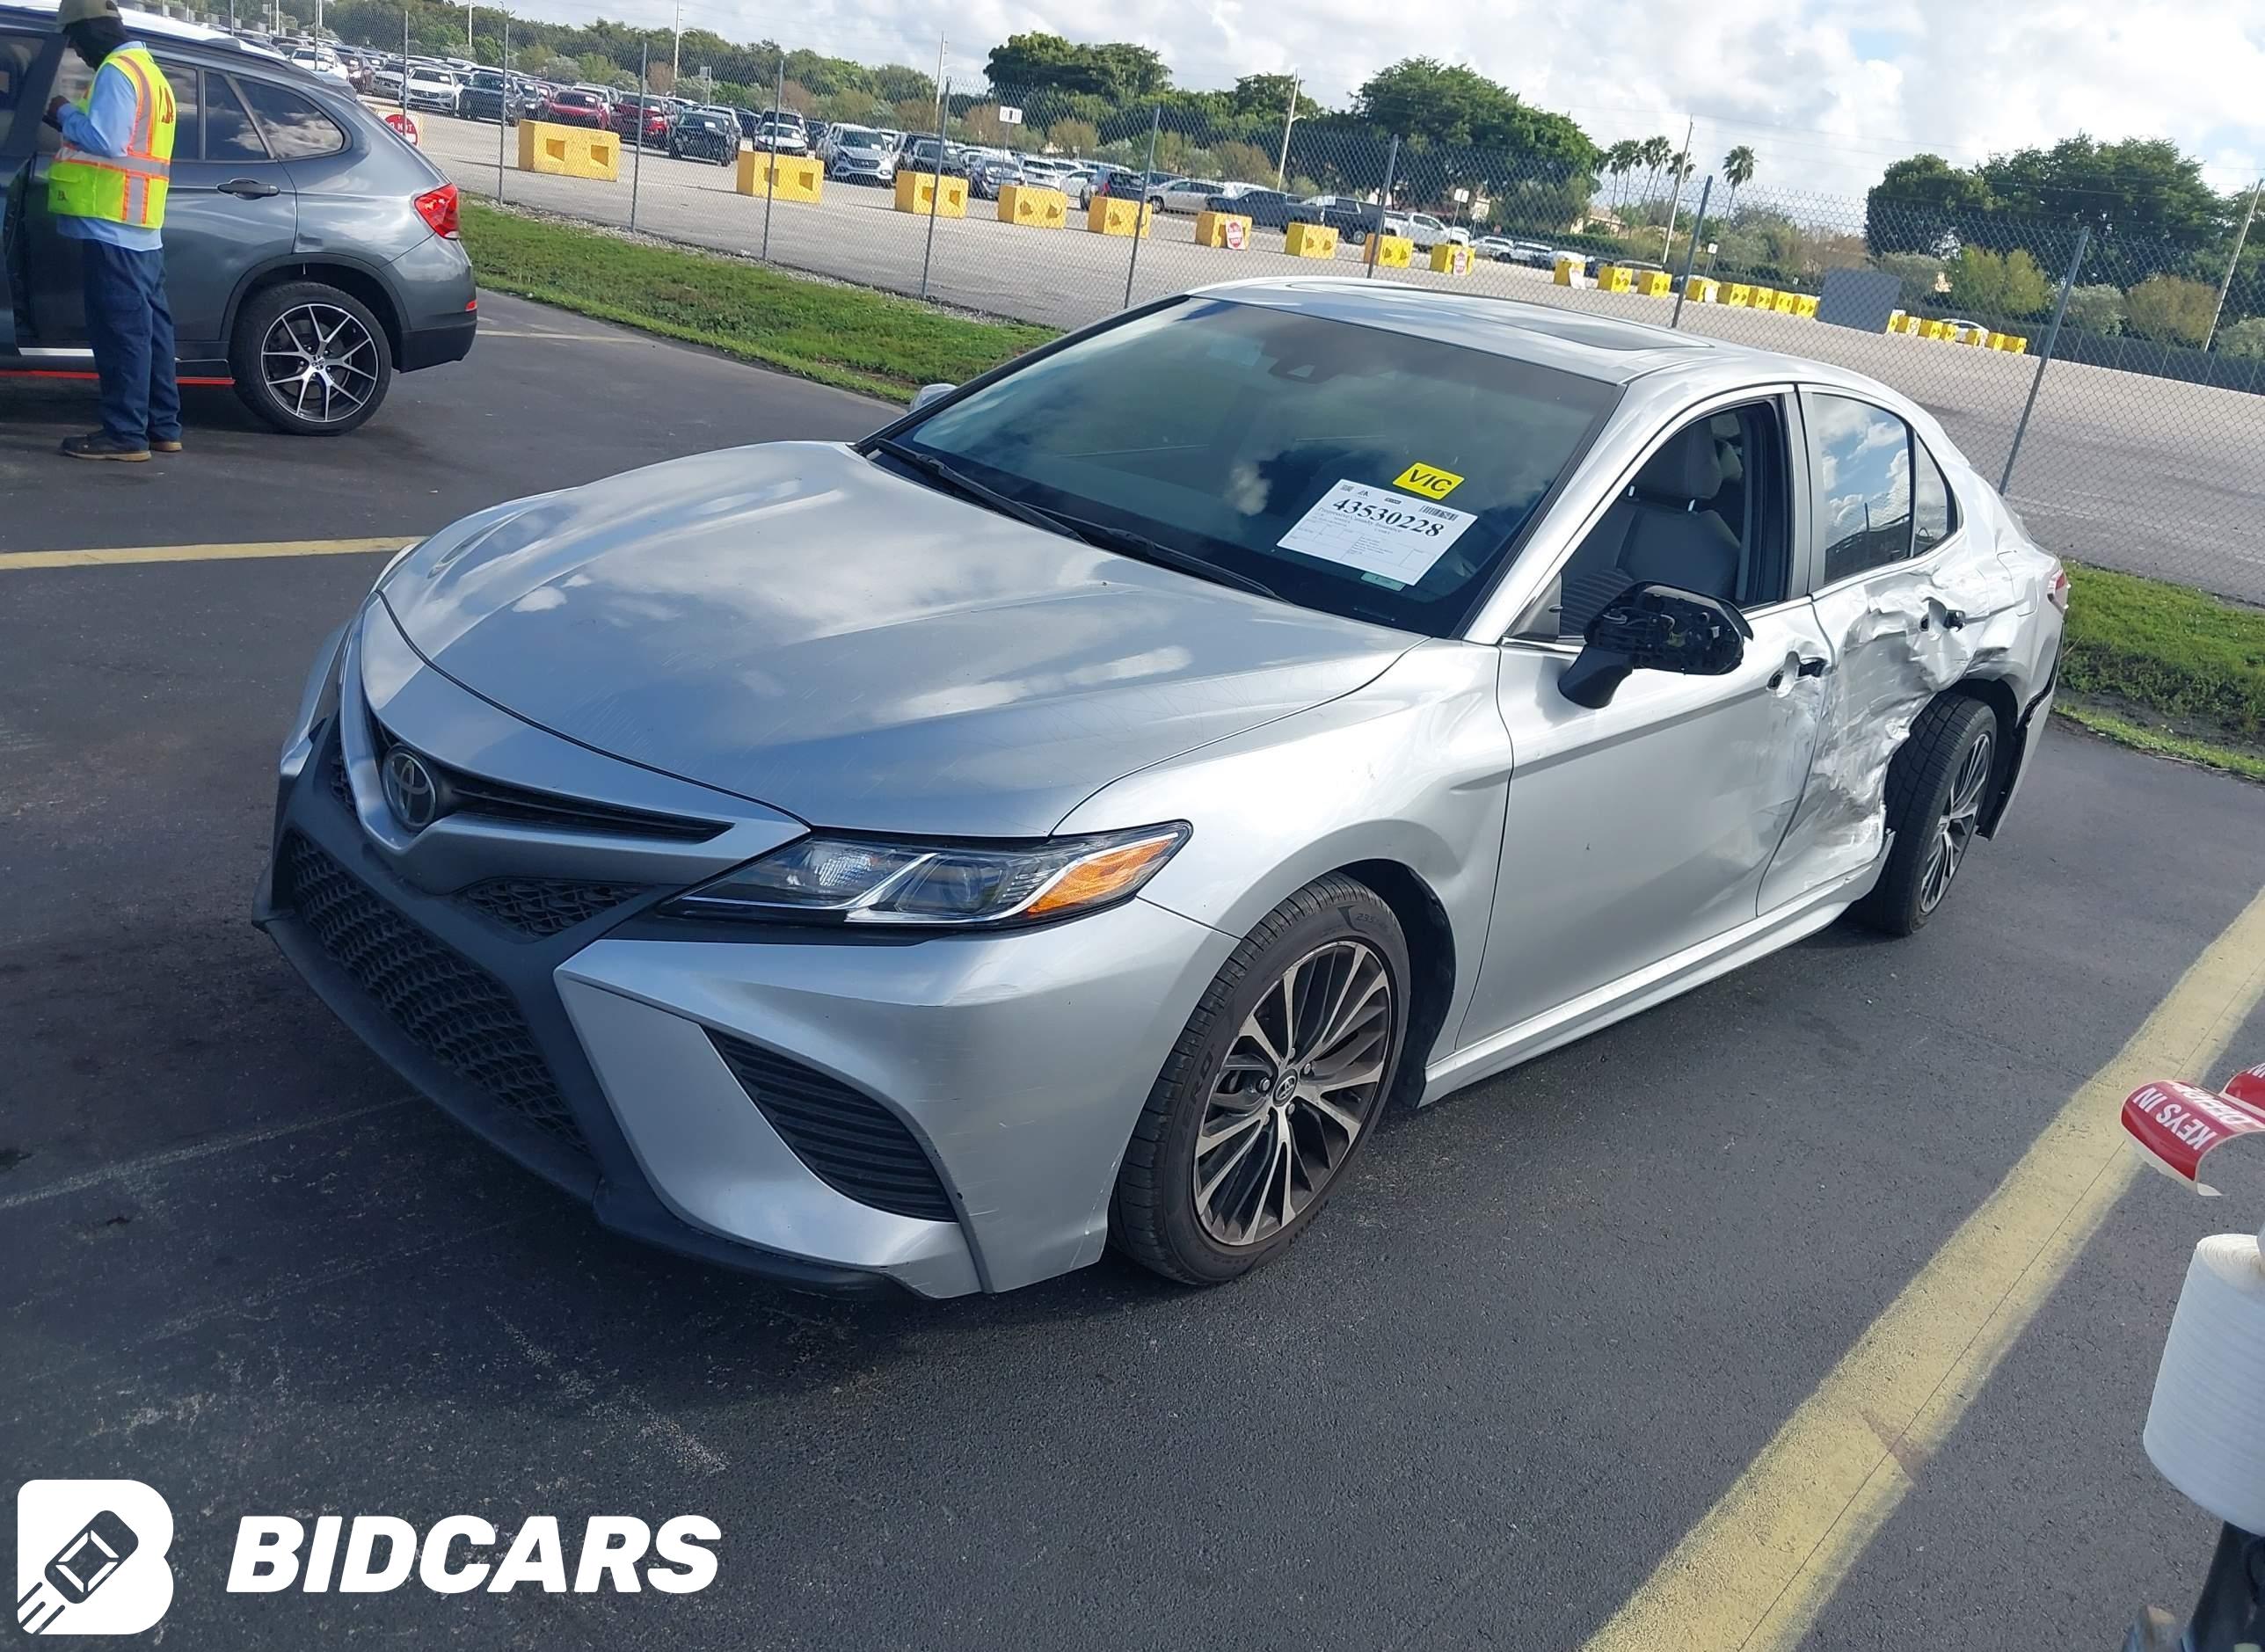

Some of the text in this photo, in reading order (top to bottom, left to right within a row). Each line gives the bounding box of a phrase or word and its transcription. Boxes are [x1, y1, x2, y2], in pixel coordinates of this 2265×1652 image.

[1409, 469, 1453, 492] VIC
[1333, 498, 1445, 537] 43530228
[2132, 1087, 2218, 1151] KEYS IN
